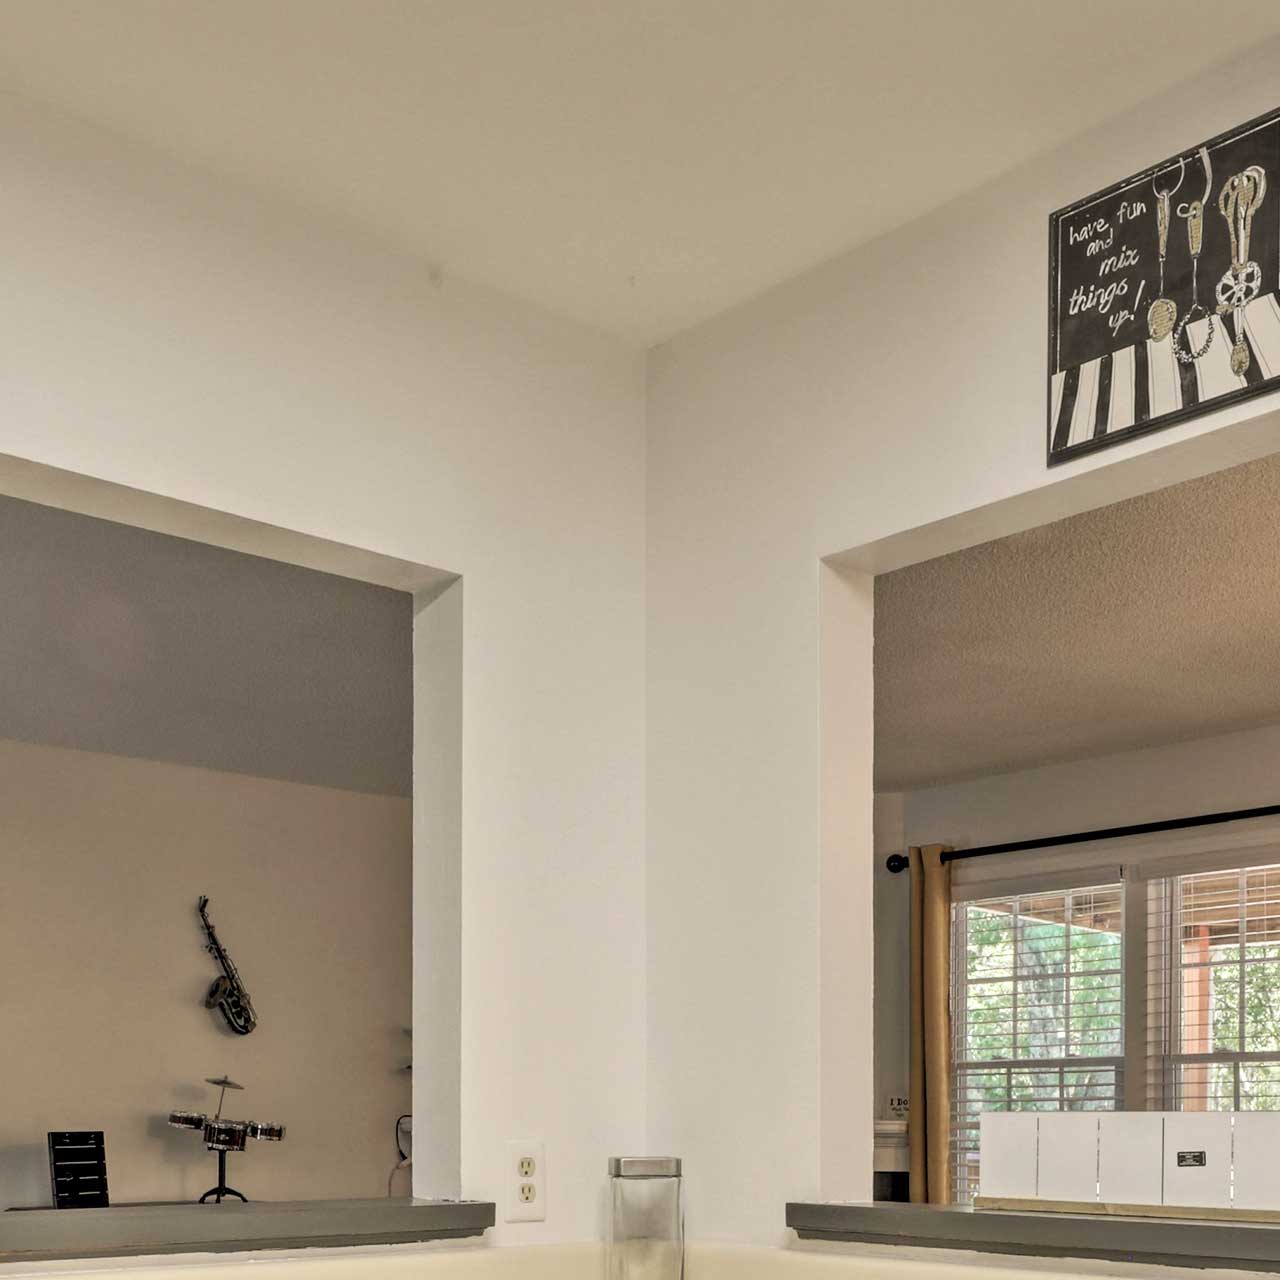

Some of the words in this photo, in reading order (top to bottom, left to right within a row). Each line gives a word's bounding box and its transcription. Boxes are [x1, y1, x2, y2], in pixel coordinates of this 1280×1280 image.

[1069, 218, 1109, 245] have
[1117, 201, 1146, 224] fun
[1086, 227, 1113, 256] and
[1099, 244, 1140, 277] mix
[1069, 278, 1128, 315] things
